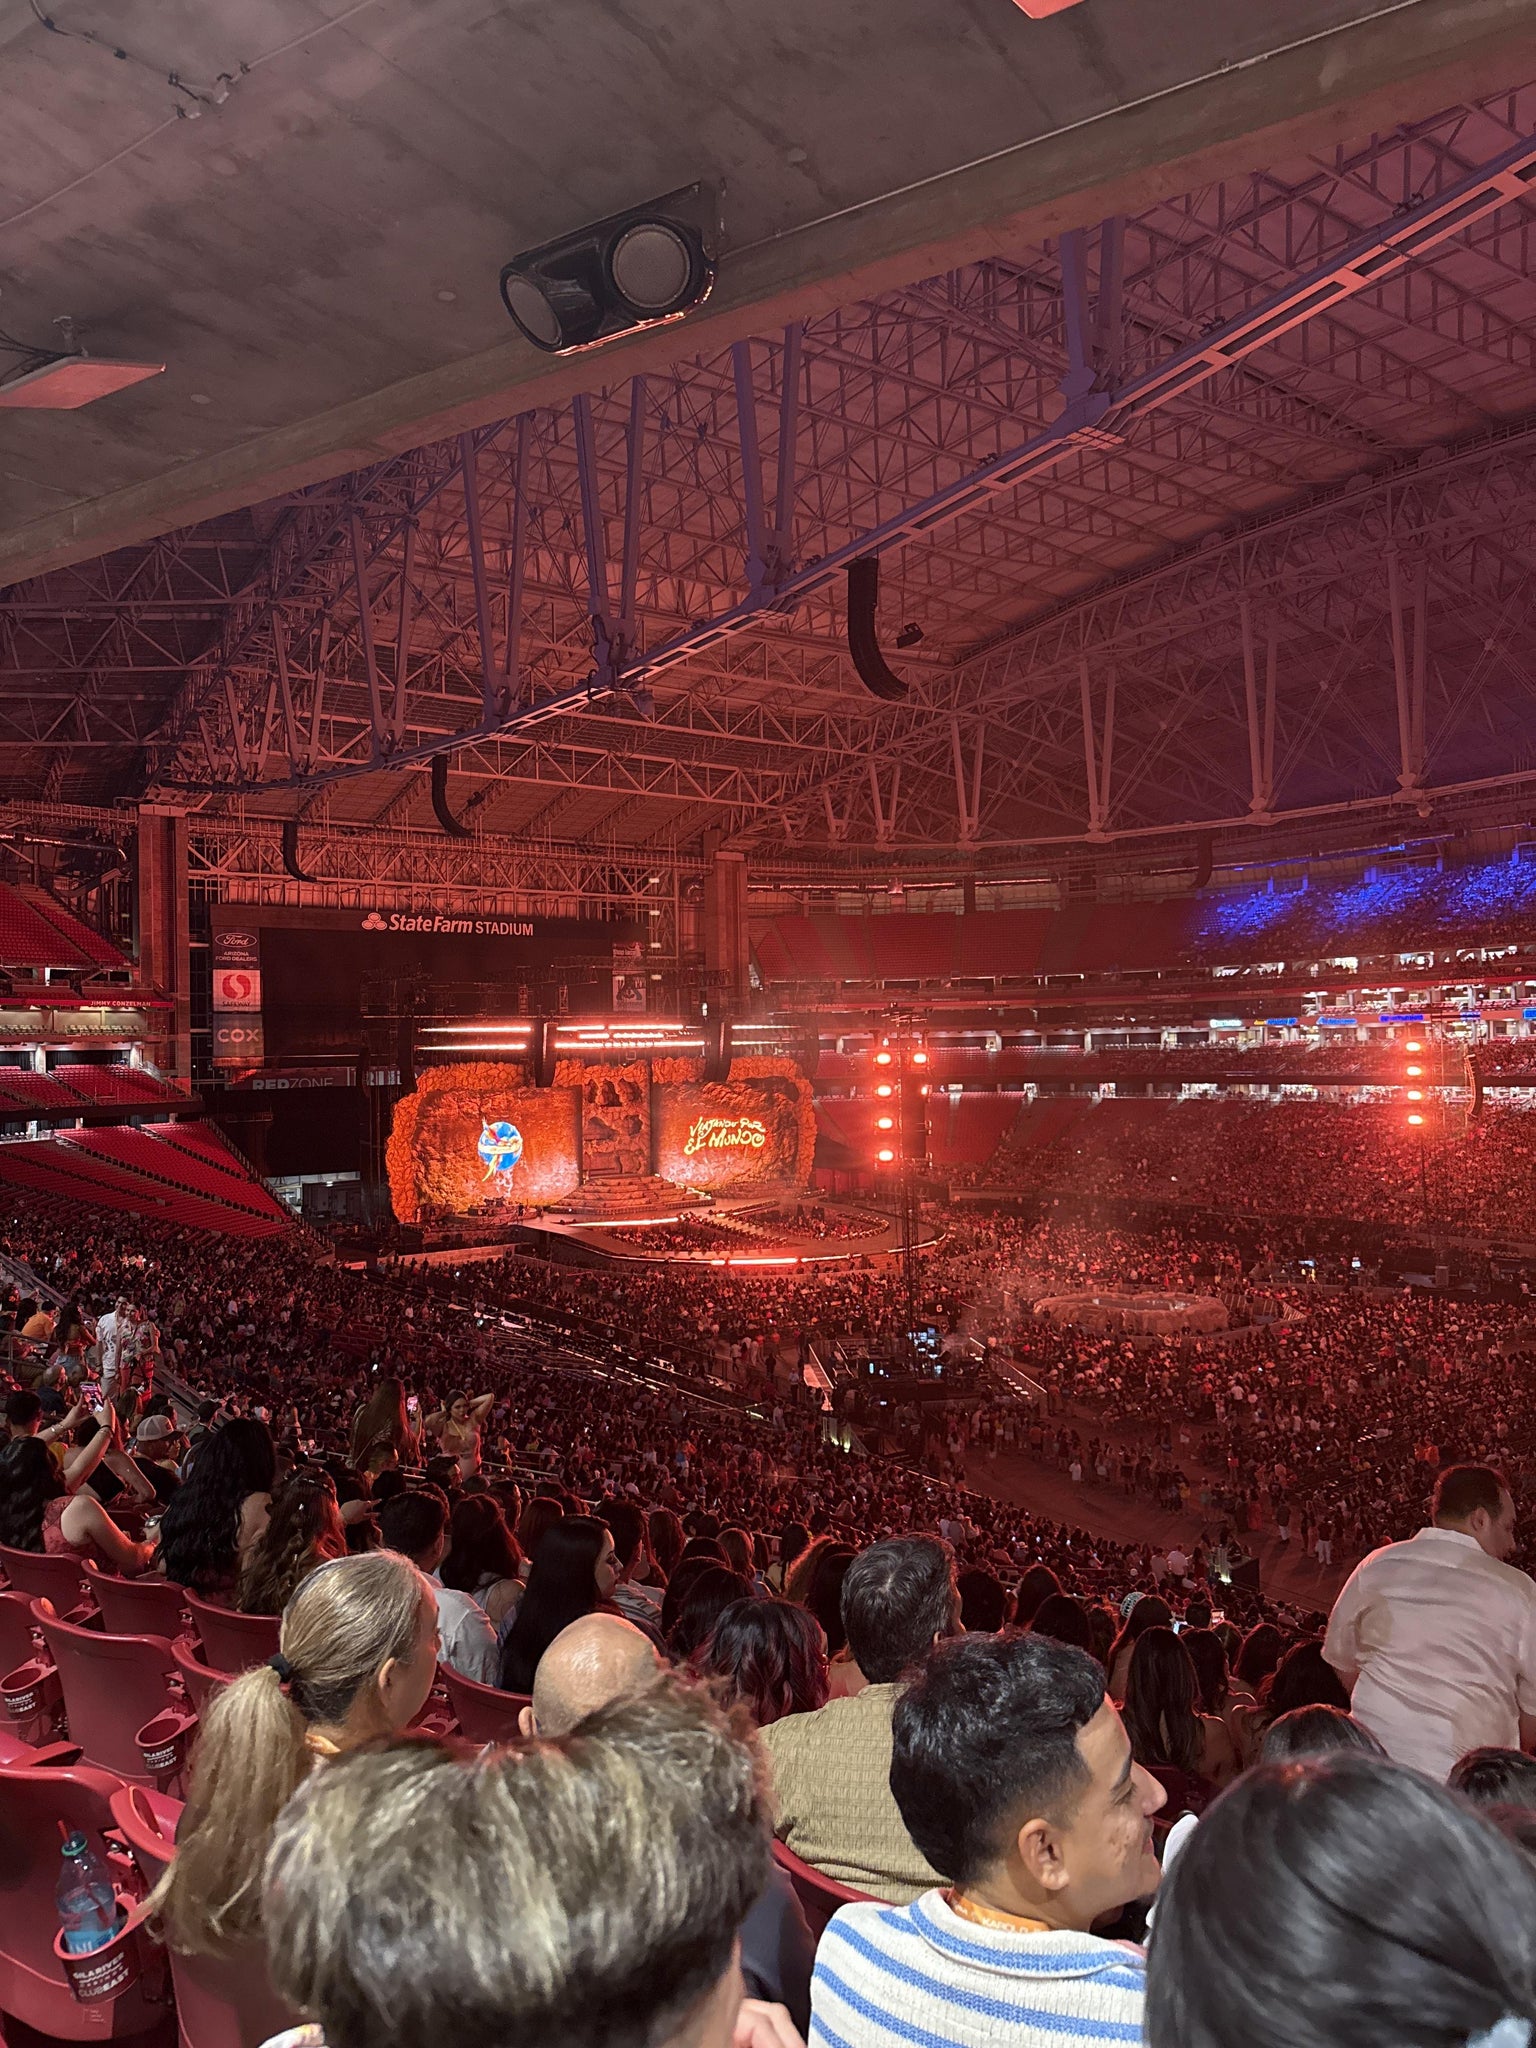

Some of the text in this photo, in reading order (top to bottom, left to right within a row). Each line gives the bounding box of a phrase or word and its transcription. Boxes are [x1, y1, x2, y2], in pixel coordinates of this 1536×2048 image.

[475, 921, 534, 936] STADIUM
[223, 934, 249, 945] Ford
[217, 1028, 259, 1043] COX
[252, 1077, 334, 1090] REDZONE
[708, 1127, 765, 1148] MUNDO
